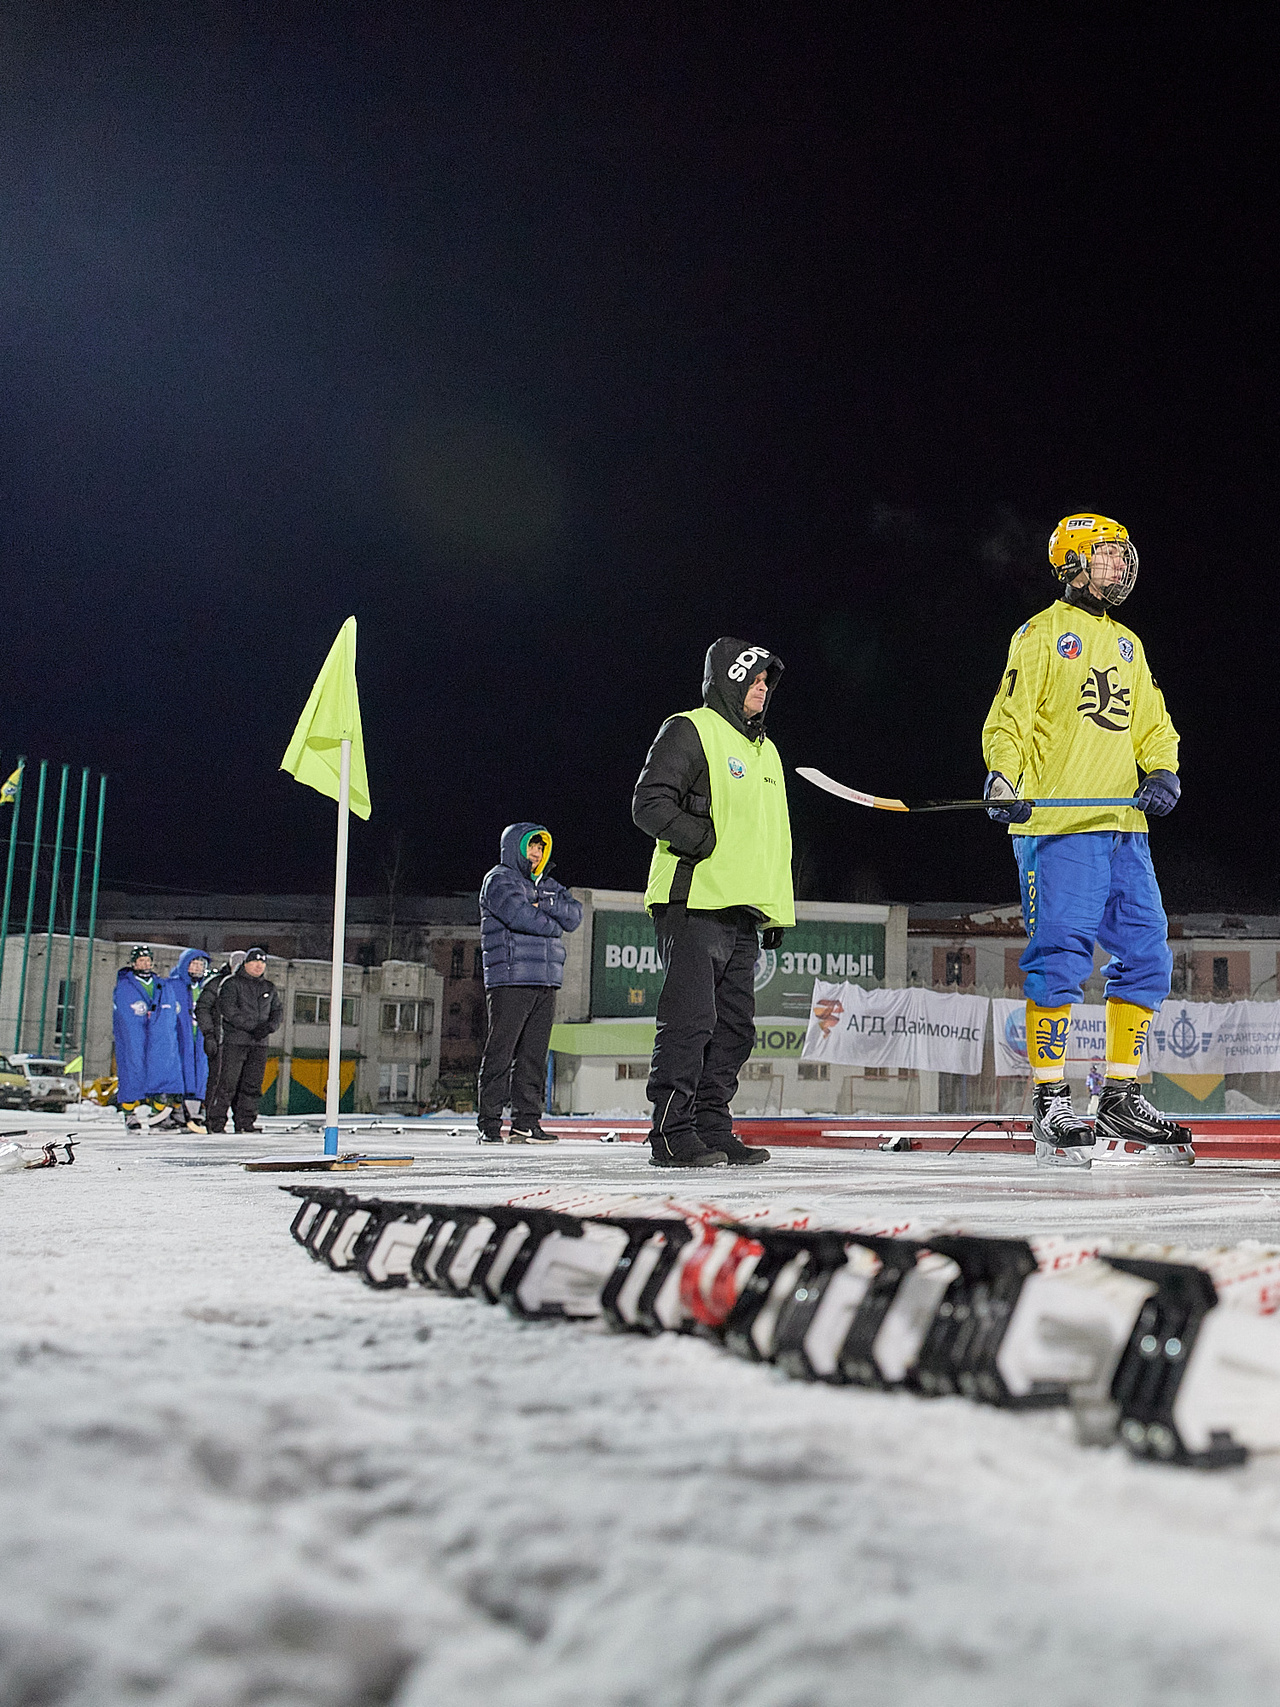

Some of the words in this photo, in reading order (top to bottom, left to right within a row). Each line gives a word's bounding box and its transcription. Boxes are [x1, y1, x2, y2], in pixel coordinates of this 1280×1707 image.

[780, 951, 823, 975] ЭТО
[826, 953, 874, 977] МЫ!
[847, 1014, 886, 1037] АГД
[892, 1015, 981, 1042] Даймондс
[1076, 1036, 1106, 1051] ТРАЛ
